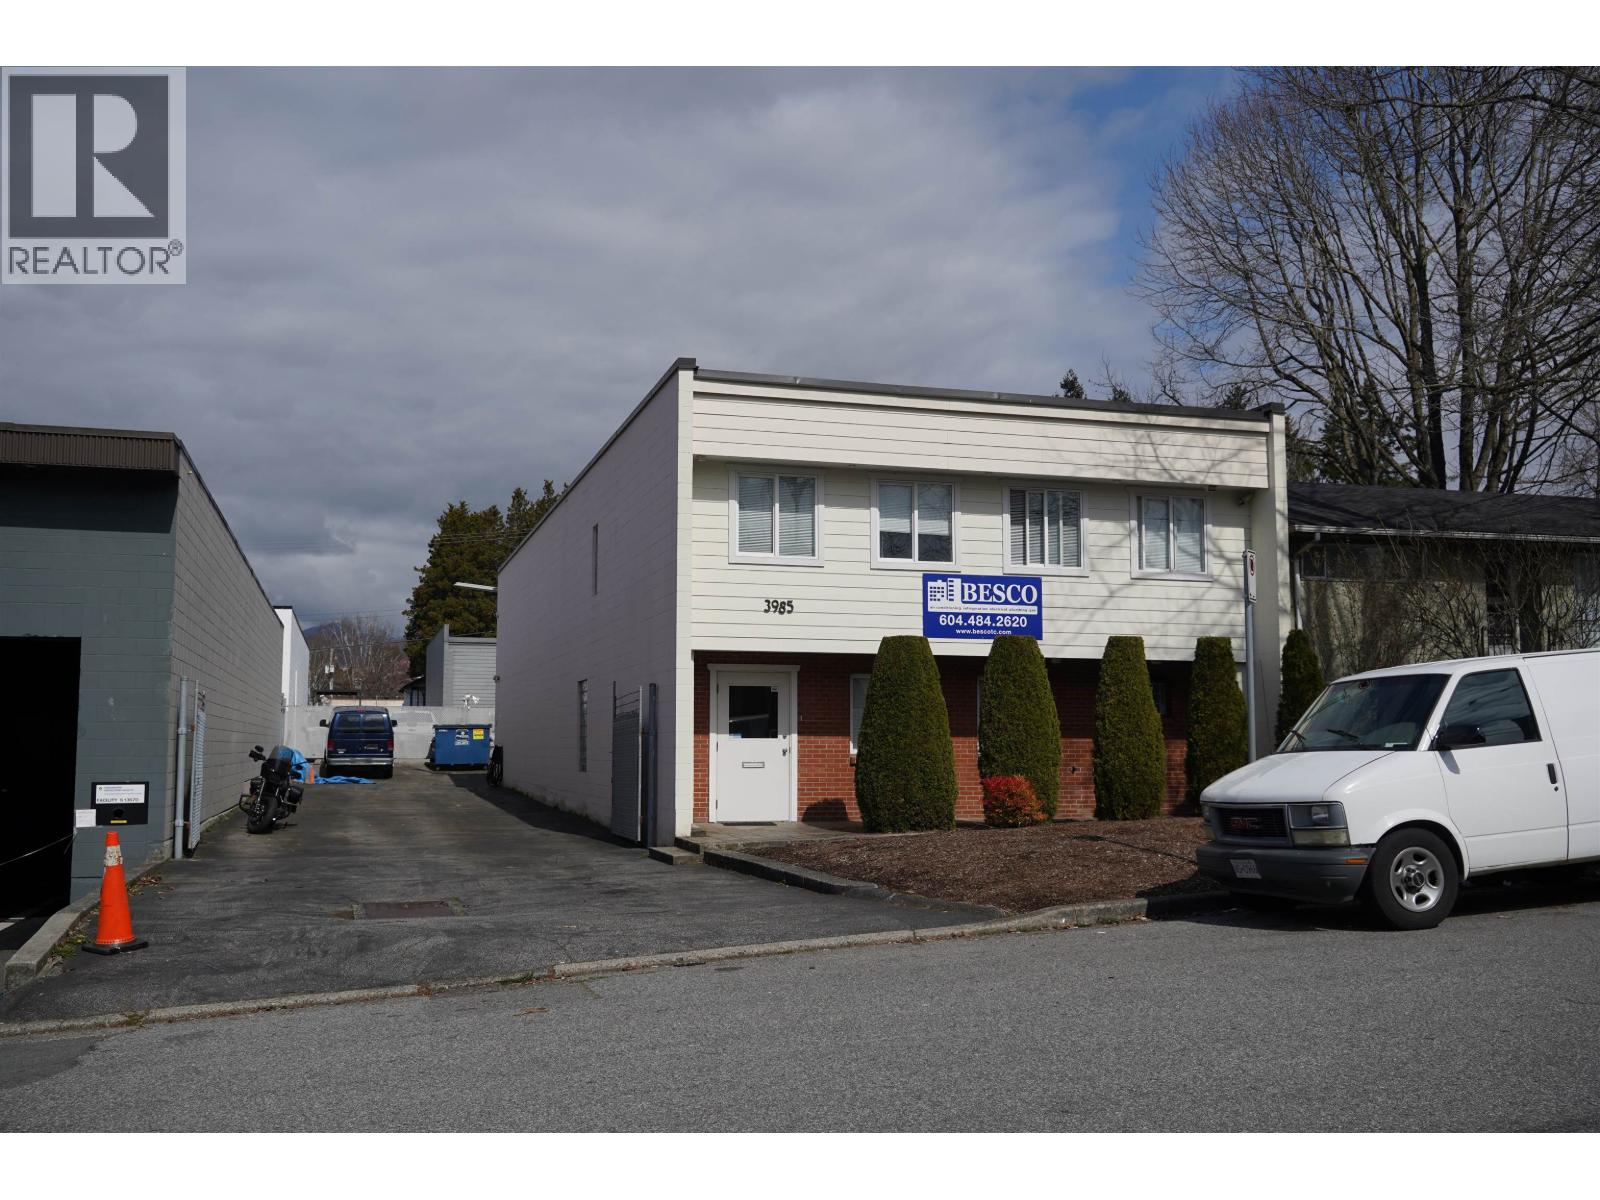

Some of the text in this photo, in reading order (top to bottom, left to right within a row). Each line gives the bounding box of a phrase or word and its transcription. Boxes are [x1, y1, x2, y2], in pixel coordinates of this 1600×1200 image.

[962, 583, 1038, 604] BESCO
[763, 599, 794, 615] 3985
[939, 614, 1028, 628] 604.484.2620
